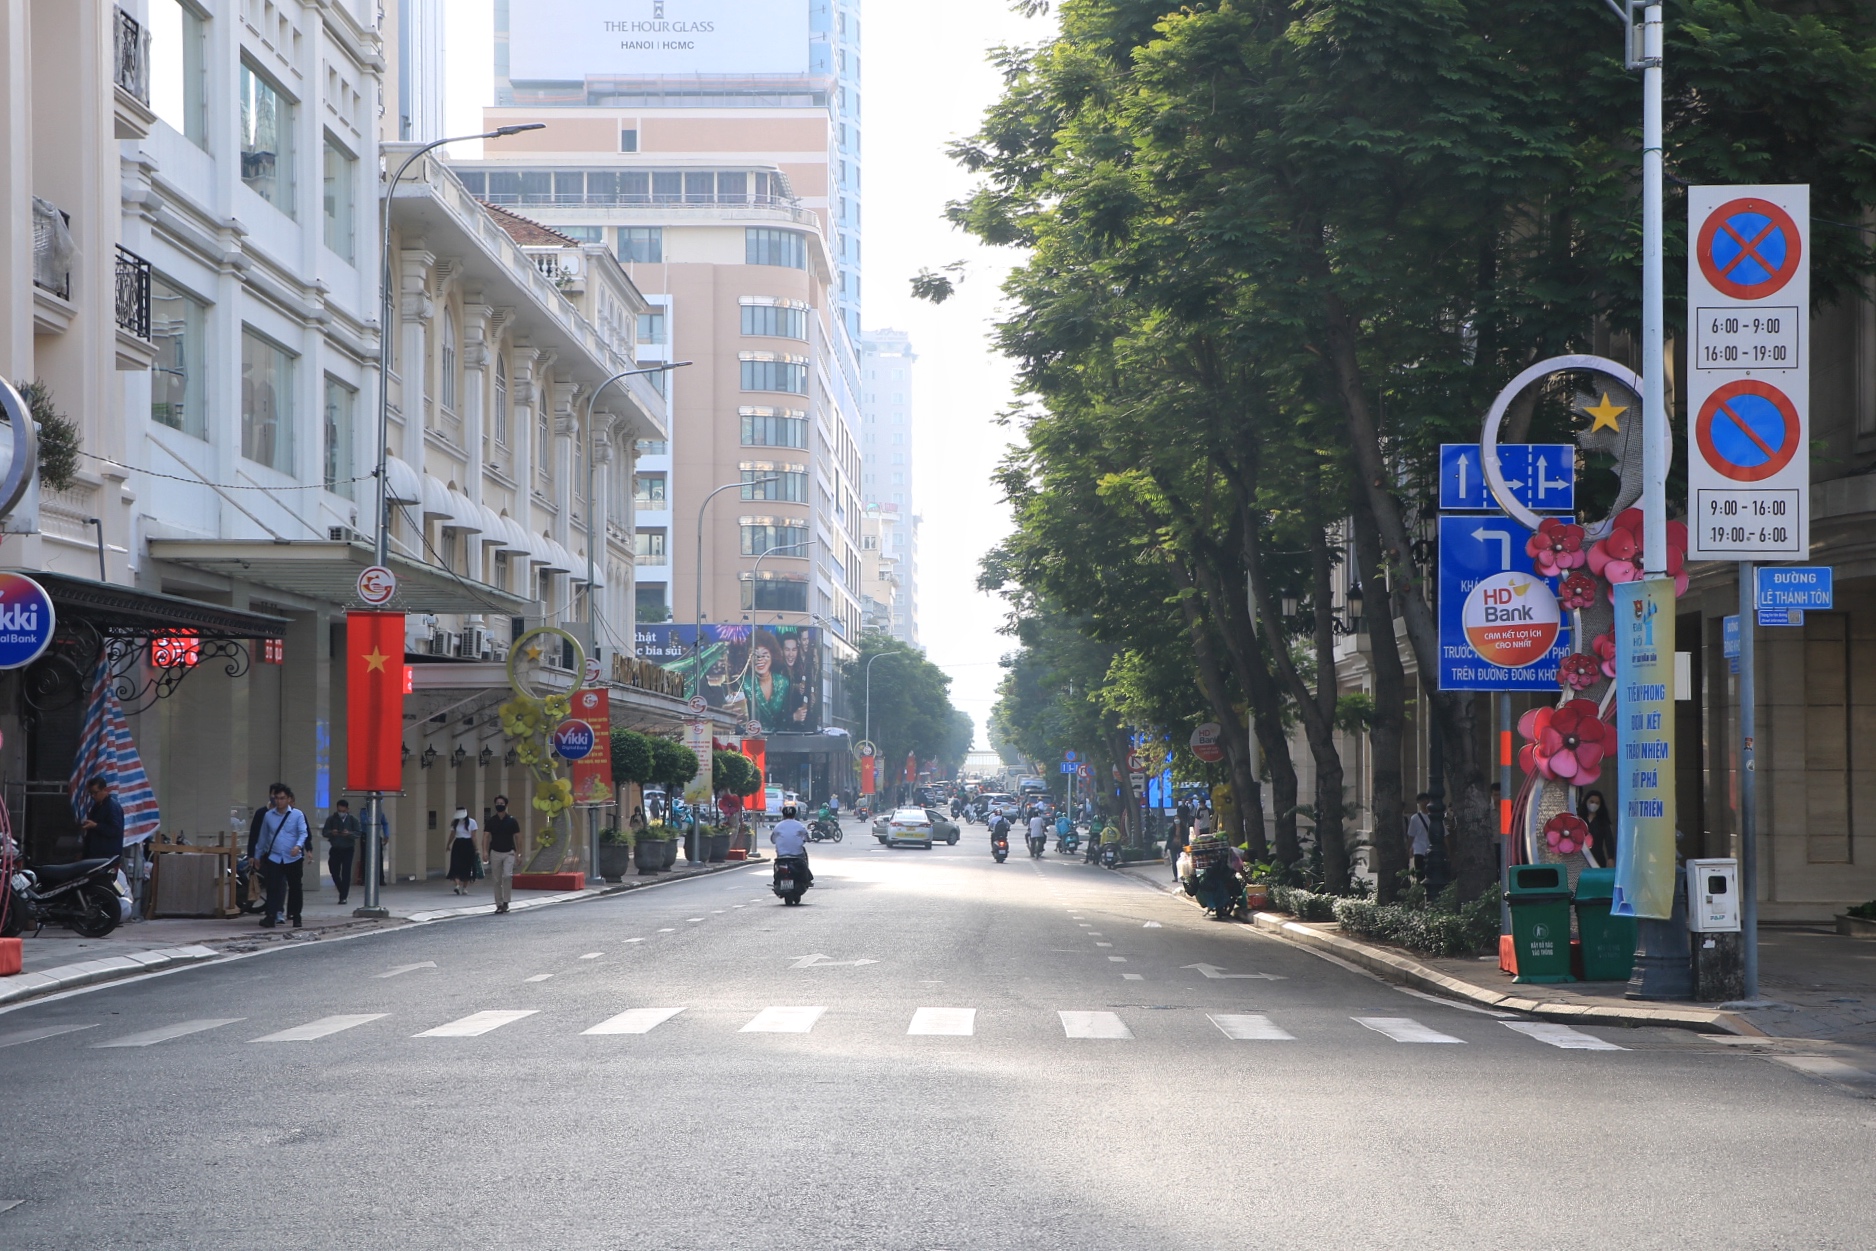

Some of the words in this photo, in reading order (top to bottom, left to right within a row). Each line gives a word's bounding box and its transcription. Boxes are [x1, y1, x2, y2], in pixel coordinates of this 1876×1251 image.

[603, 21, 628, 32] THE
[631, 21, 670, 32] HOUR
[672, 21, 715, 32] GLASS
[621, 41, 654, 50] HANOI
[662, 41, 695, 50] HCMC
[1711, 318, 1738, 334] 6:00
[1753, 318, 1780, 334] 9:00
[1704, 345, 1738, 361] 16:00
[1752, 345, 1786, 361] 19:00
[1710, 500, 1737, 516] 9:00
[1752, 500, 1786, 516] 16:00
[1711, 527, 1745, 542] 19:00
[1759, 527, 1786, 542] 6:00
[1773, 571, 1817, 584] ĐƯỜNG
[1483, 588, 1512, 605] HD
[1761, 588, 1773, 604] LÊ
[1775, 587, 1808, 604] THÁNH
[1810, 588, 1829, 604] TÔN
[1484, 605, 1533, 622] Bank
[11, 633, 37, 643] Bank
[1484, 632, 1501, 640] CAM
[1529, 629, 1542, 638] ÍCH
[645, 646, 663, 656] bia
[1444, 643, 1474, 658] TRƯỚC
[1495, 641, 1511, 649] CAO
[1513, 639, 1532, 648] NHẤT
[1452, 665, 1475, 681] TRÊN
[1477, 664, 1509, 680] ĐƯỜNG
[1646, 709, 1661, 730] KẾT
[557, 727, 588, 745] Vikki
[1641, 739, 1668, 762] NHIỆM
[1641, 769, 1657, 788] PHÁ
[1639, 797, 1663, 817] TRIỂN
